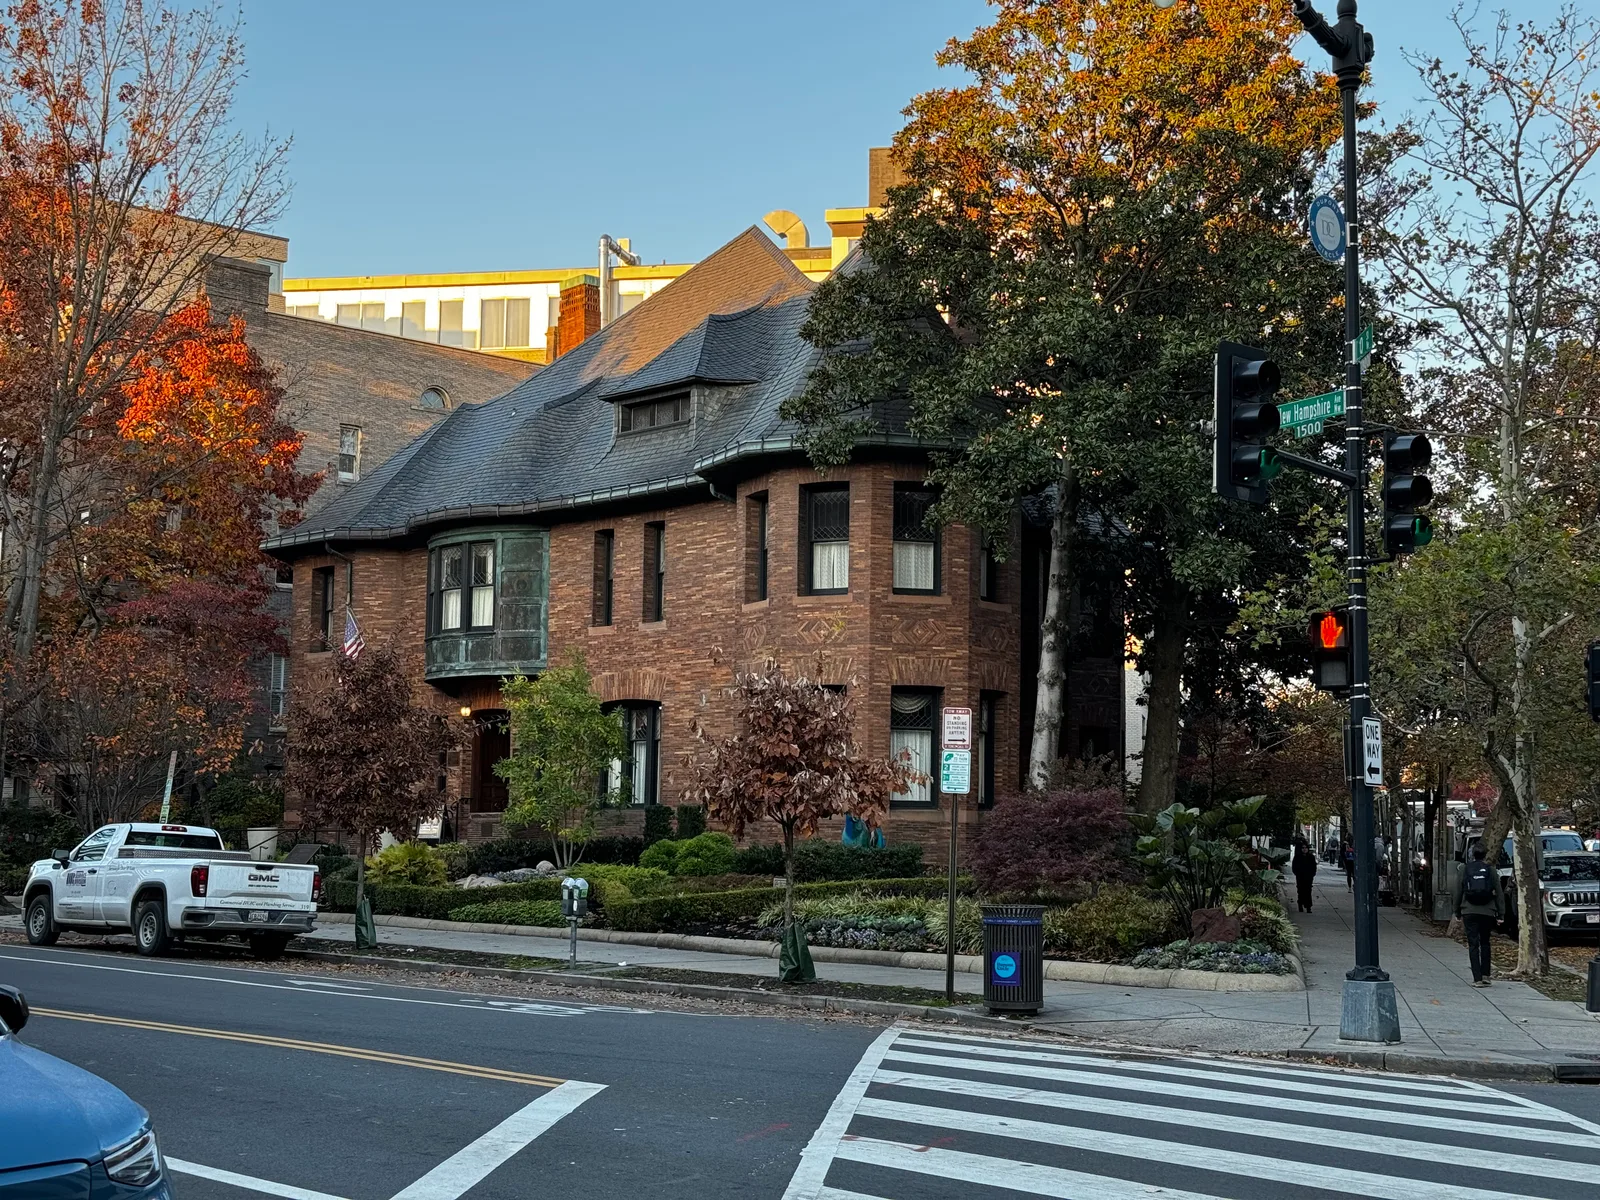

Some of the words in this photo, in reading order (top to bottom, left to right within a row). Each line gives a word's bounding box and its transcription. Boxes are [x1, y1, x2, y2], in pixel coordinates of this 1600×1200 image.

[1316, 198, 1339, 214] DUPONT
[1317, 245, 1340, 259] CIRCLE
[1293, 397, 1331, 421] Hampshire
[1297, 421, 1321, 438] 1500
[1365, 724, 1379, 740] ONE
[1366, 743, 1380, 759] WAY
[248, 874, 280, 882] GMC
